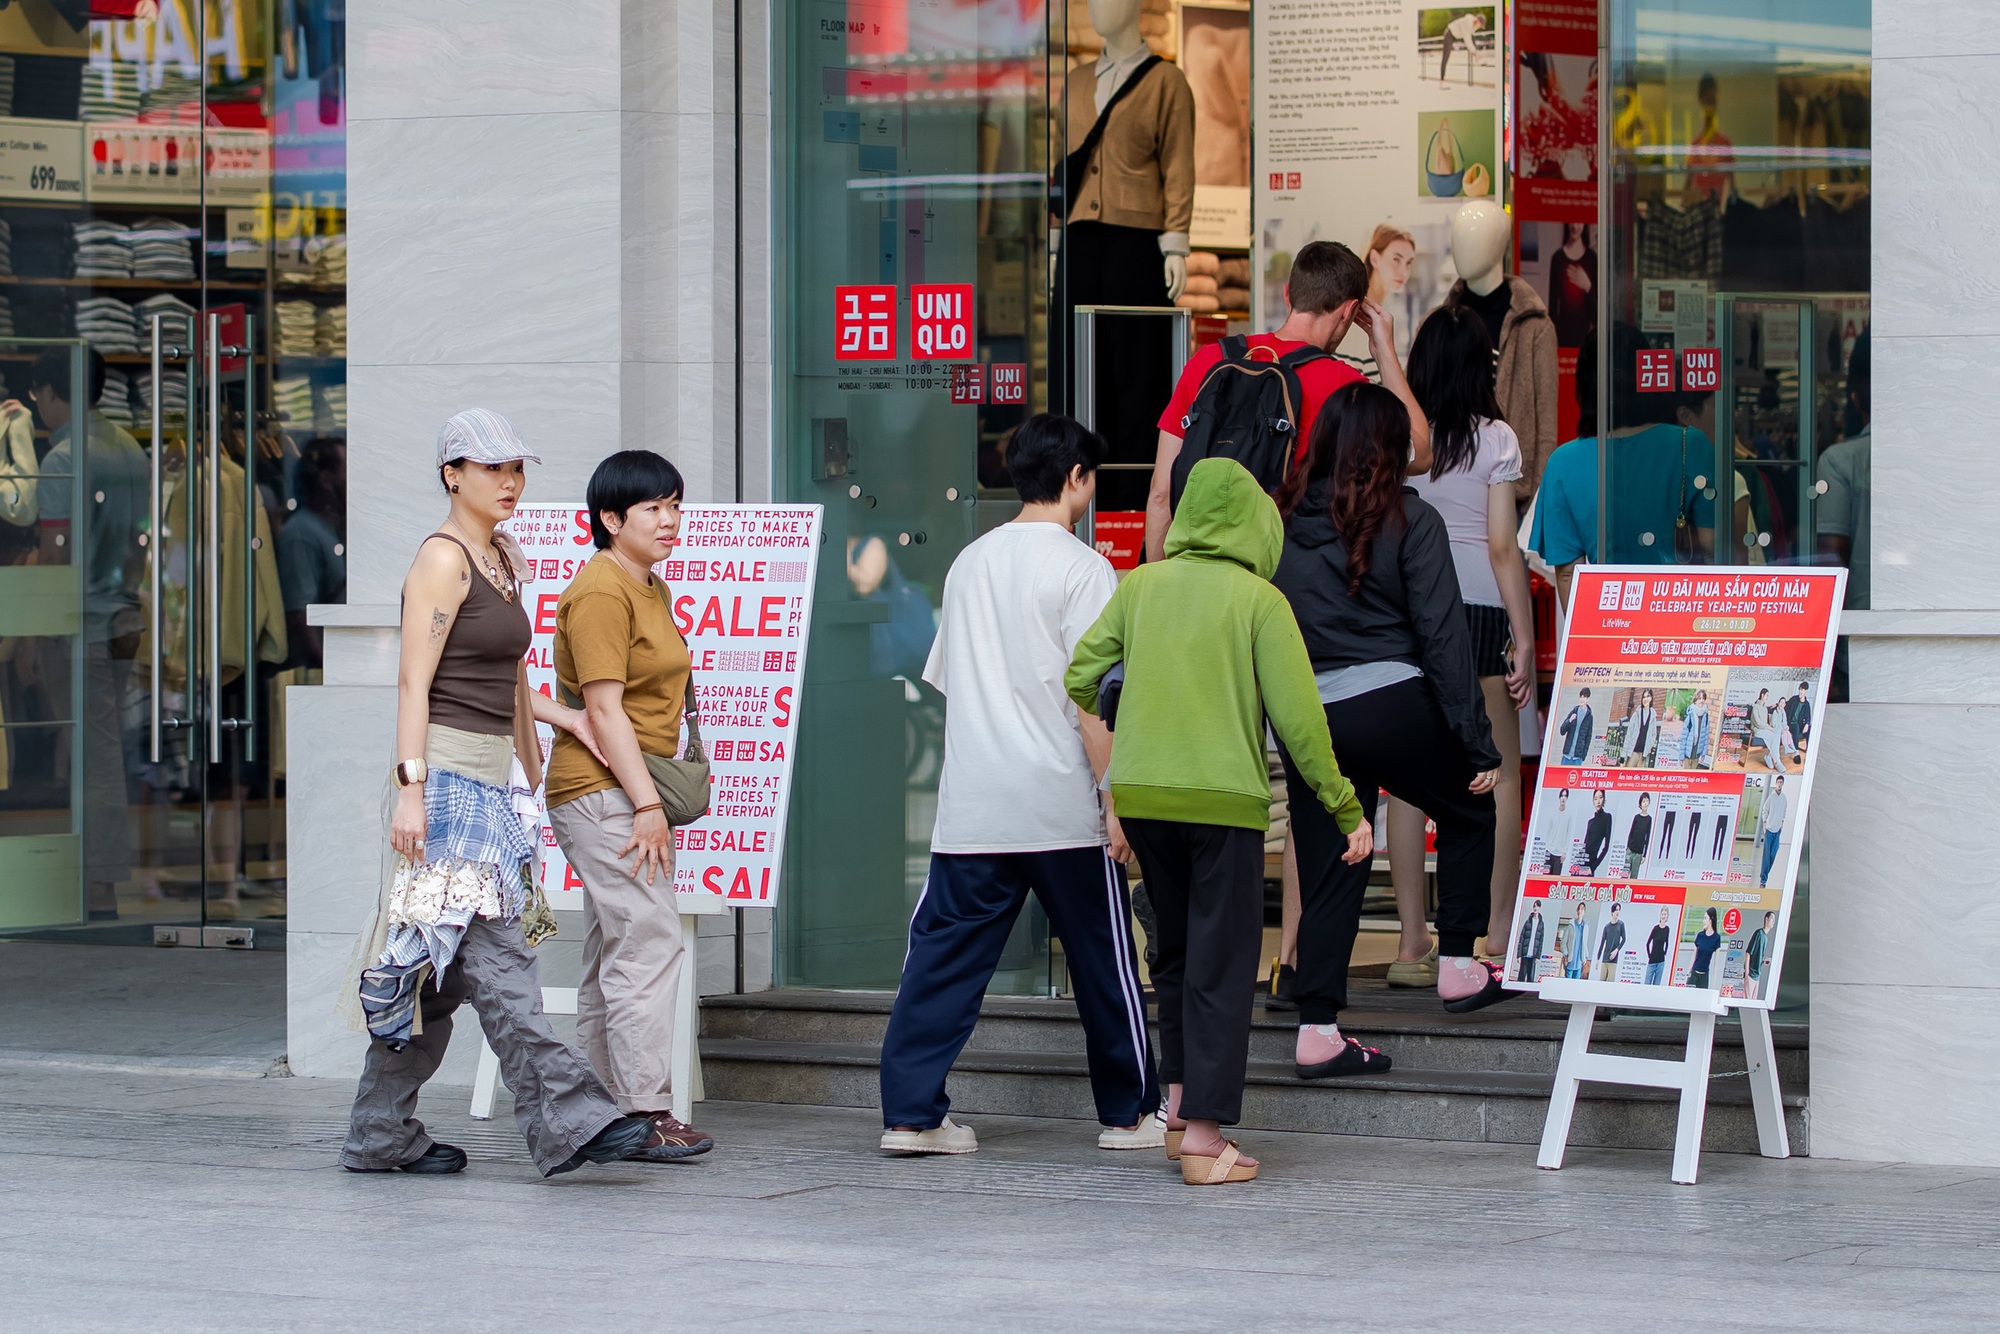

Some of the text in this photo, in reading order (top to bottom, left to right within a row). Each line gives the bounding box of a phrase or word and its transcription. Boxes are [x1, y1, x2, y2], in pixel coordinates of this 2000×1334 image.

[821, 20, 846, 32] FLOOR
[849, 22, 866, 34] MAP
[30, 165, 56, 191] 699
[917, 293, 962, 319] UNI
[917, 324, 966, 355] QLO
[1686, 353, 1714, 369] UNI
[851, 367, 863, 376] HAI
[905, 364, 932, 375] 10:00
[942, 364, 970, 375] 22:00
[995, 368, 1020, 383] UNI
[838, 382, 861, 390] MONDAY
[905, 379, 932, 389] 10:00
[942, 379, 970, 389] 22:00
[1686, 371, 1717, 388] QLO
[995, 385, 1022, 401] QLO
[688, 521, 733, 533] PRICES
[741, 521, 756, 533] TO
[762, 522, 798, 533] MAKE
[538, 532, 564, 545] NGÀY
[687, 535, 810, 547] EVERYDAY COMFORTA
[690, 562, 704, 570] UNI
[709, 561, 767, 581] SALE
[688, 571, 703, 580] QLO
[1627, 585, 1641, 595] UNI
[1672, 578, 1693, 597] ĐÃI
[1695, 581, 1720, 597] MUA
[1783, 578, 1810, 598] NĂM
[1625, 597, 1640, 608] QLO
[1649, 601, 1805, 614] CELEBRATE YEAR-END FESTIVAL
[674, 595, 786, 637] SALE
[1602, 618, 1632, 628] LifeWear
[1701, 620, 1749, 629] 26.12 01.01
[1574, 667, 1612, 677] PUFFTECH
[694, 686, 769, 698] EASONABLE
[735, 701, 768, 712] YOUR
[739, 742, 753, 751] UNI
[738, 751, 753, 760] QLO
[1581, 770, 1608, 778] HEATTECH
[720, 776, 780, 788] ITEMS AT
[718, 790, 763, 803] PRICES
[716, 805, 776, 818] EVERYDAY
[690, 831, 705, 840] UNI
[709, 830, 767, 852] SALE
[688, 840, 703, 850] QLO
[677, 867, 695, 880] GIÁ
[1608, 867, 1619, 876] 299
[1663, 870, 1675, 879] 499
[1701, 871, 1713, 880] 299
[1597, 884, 1614, 901] GIÁ
